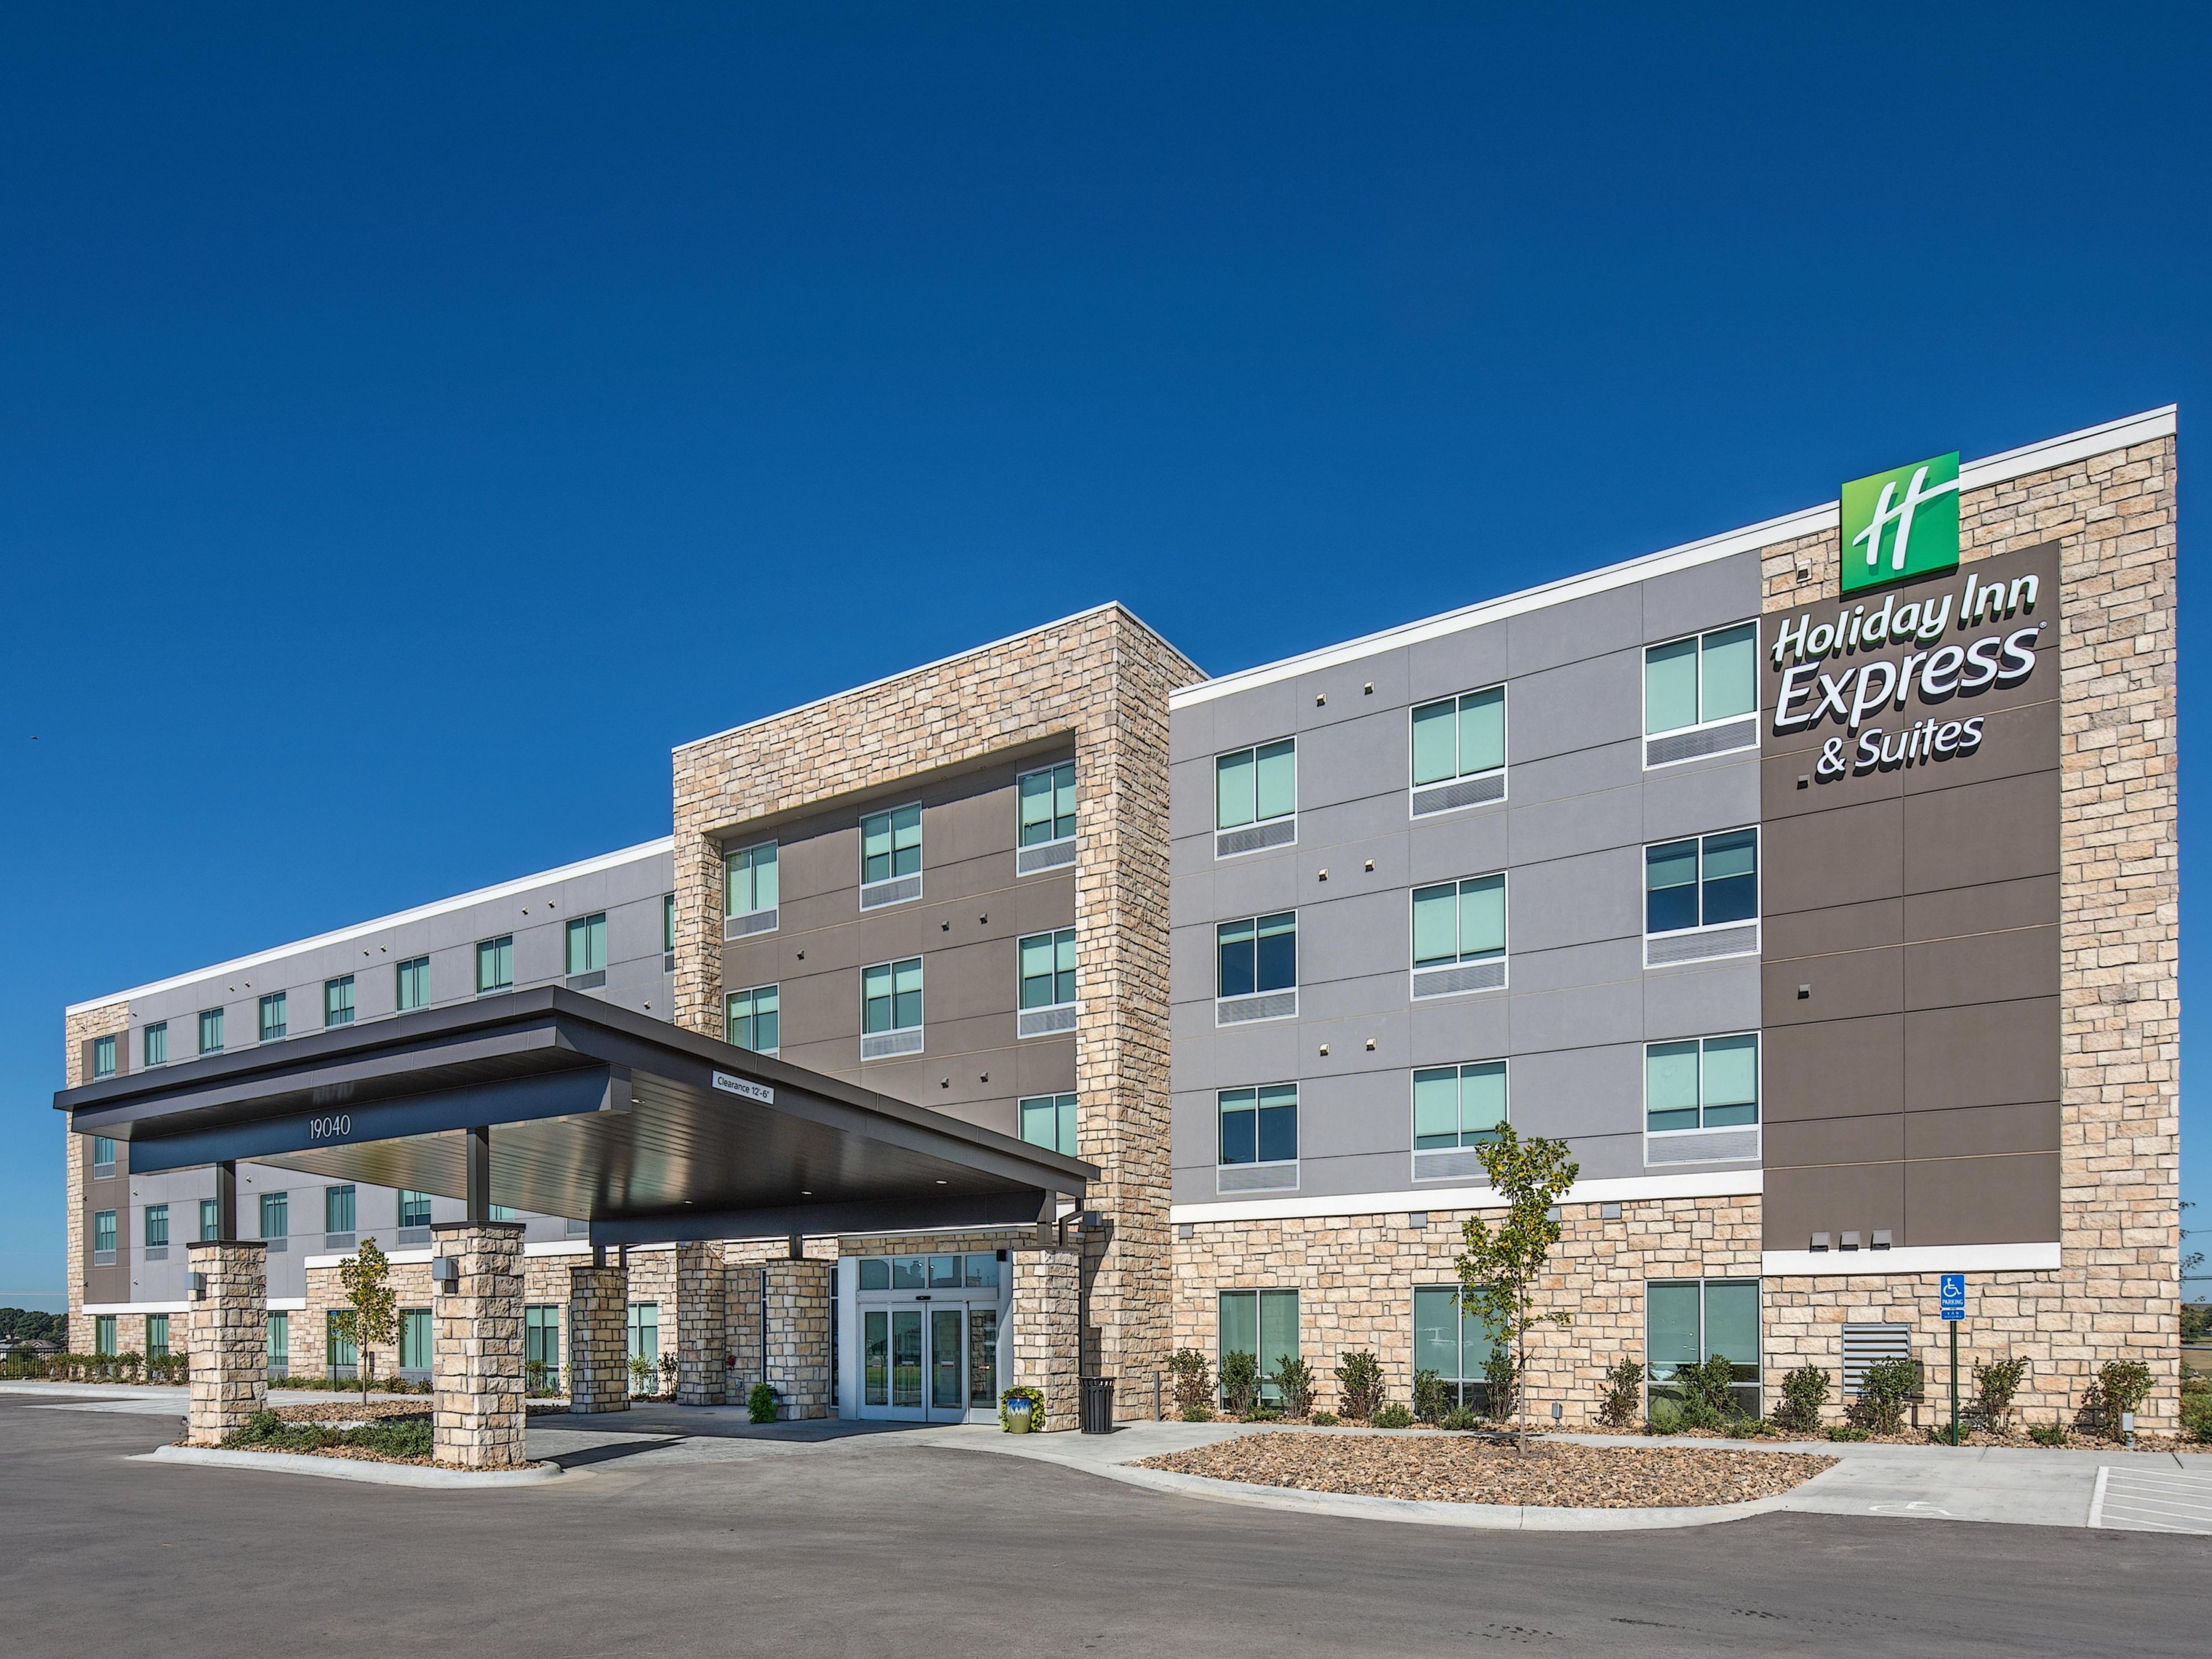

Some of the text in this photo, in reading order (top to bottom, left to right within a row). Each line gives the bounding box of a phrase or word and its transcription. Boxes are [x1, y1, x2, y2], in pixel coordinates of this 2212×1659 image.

[1772, 573, 2039, 662] Holiday Inn
[1774, 628, 2038, 728] Express
[1816, 717, 1985, 774] & Suites
[717, 1076, 750, 1093] Clearance
[310, 1114, 351, 1139] 19040
